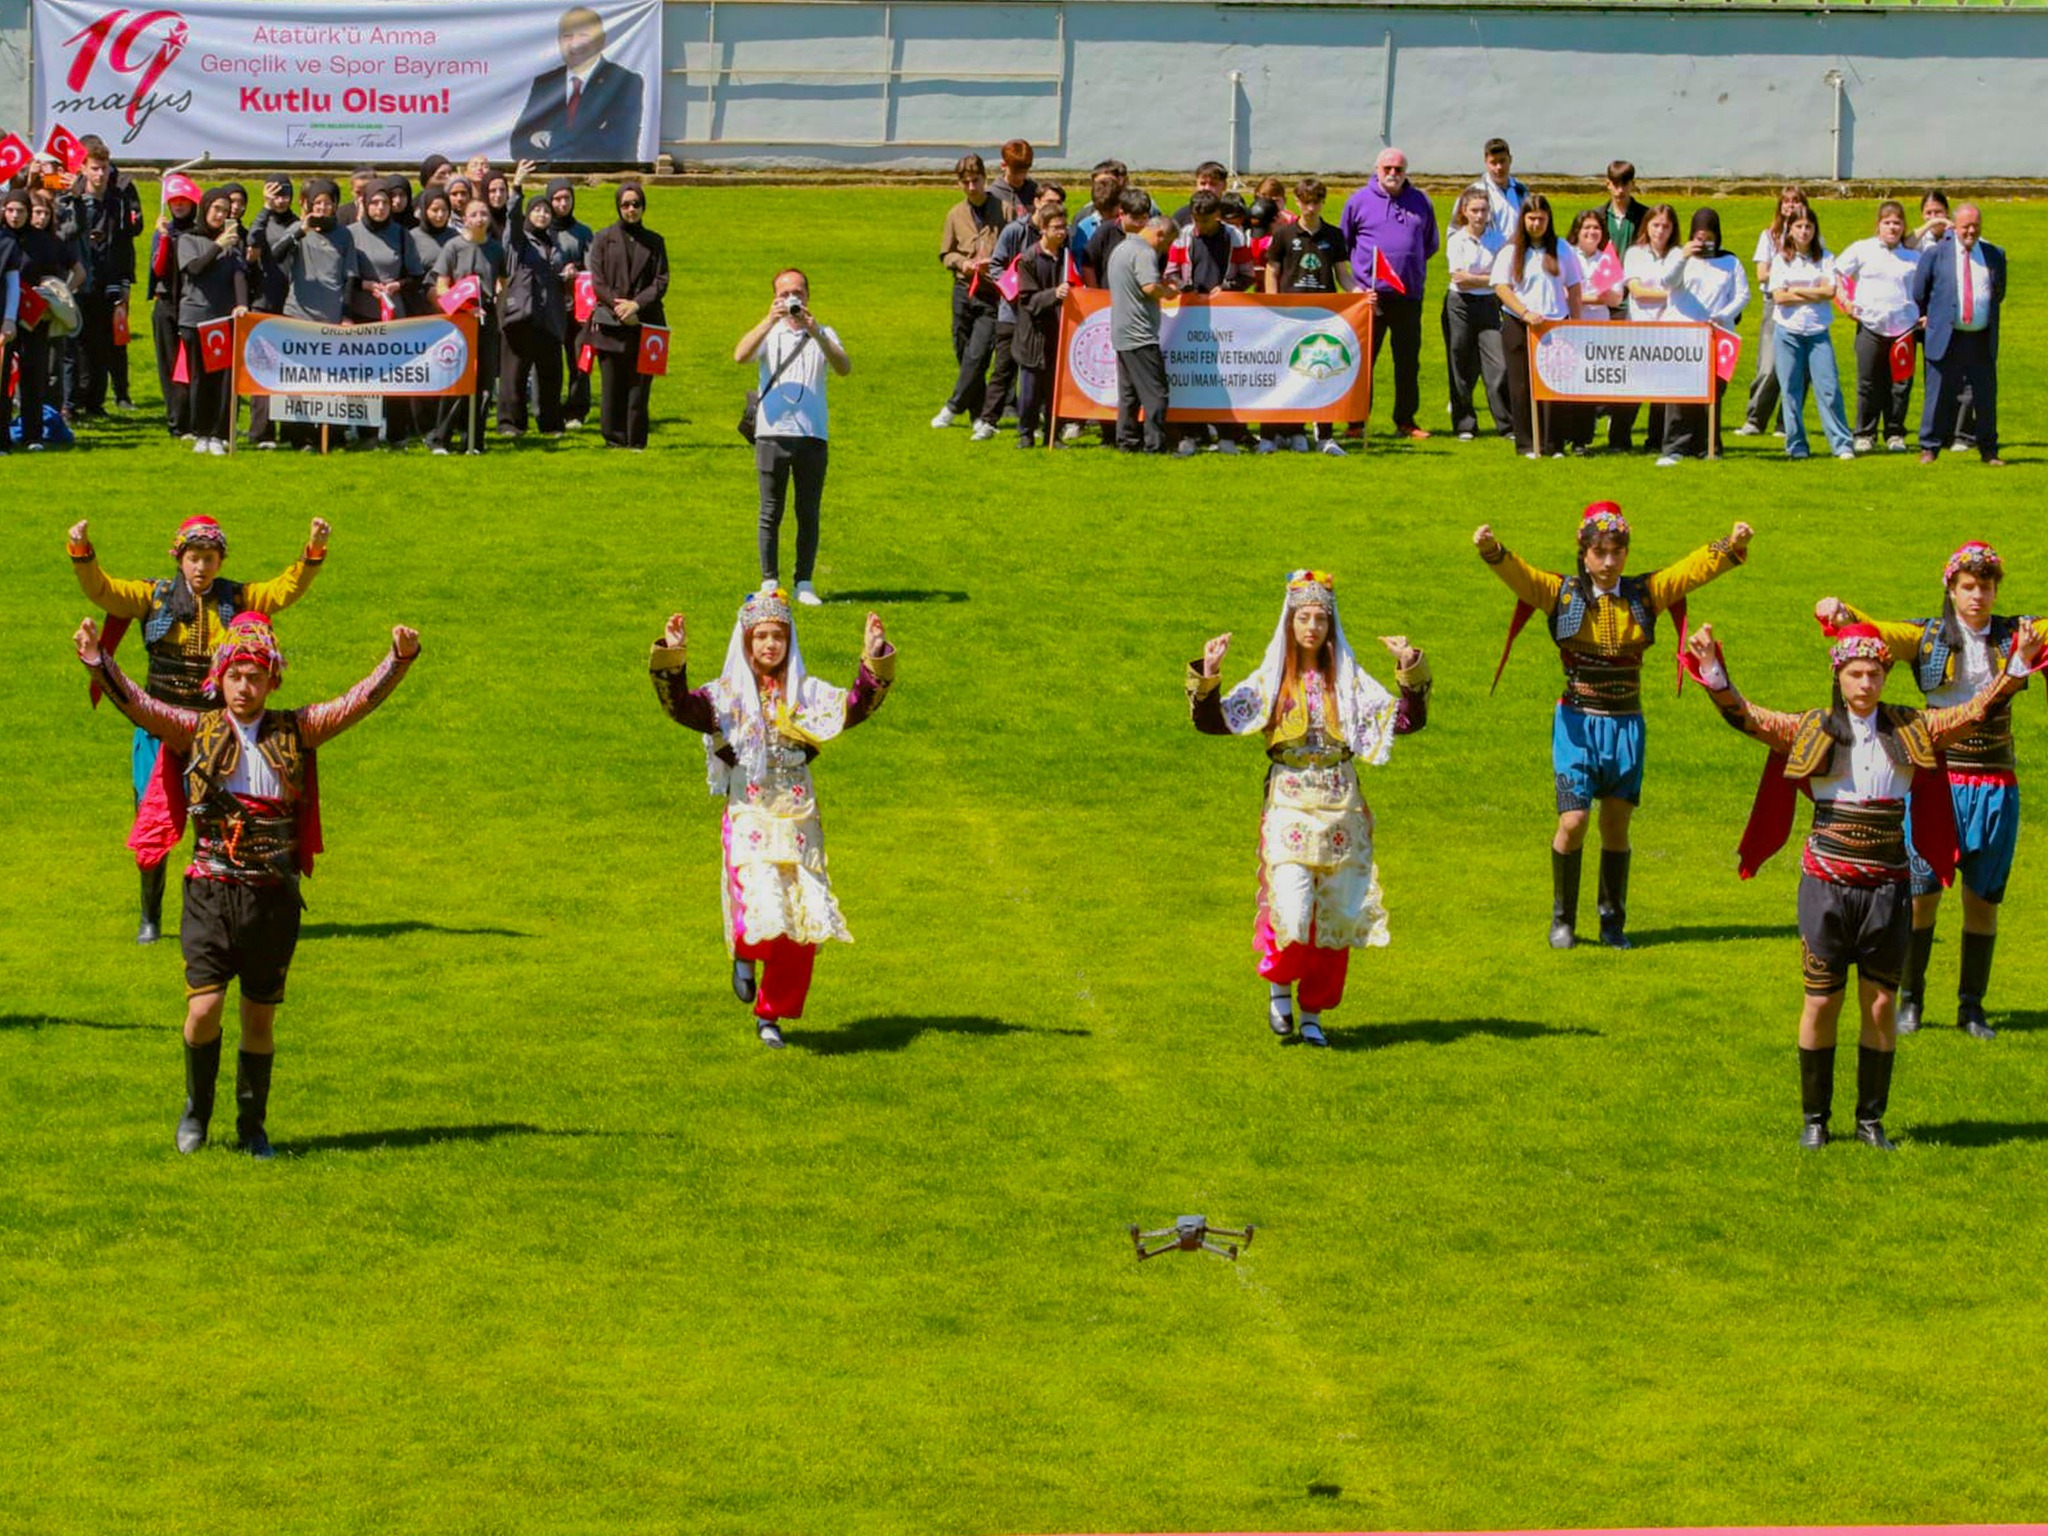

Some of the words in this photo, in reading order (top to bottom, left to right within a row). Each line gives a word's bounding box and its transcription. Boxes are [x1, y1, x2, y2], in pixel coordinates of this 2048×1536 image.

[253, 26, 361, 45] Atatürk'ü
[369, 27, 437, 46] Anma
[201, 54, 287, 77] Gençlik
[295, 59, 322, 73] ve
[330, 55, 385, 77] Spor
[394, 56, 488, 78] Bayramı
[239, 87, 331, 112] Kutlu
[343, 88, 449, 113] Olsun!
[282, 339, 332, 355] ÜNYE
[338, 341, 426, 356] ANADOLU
[1170, 347, 1199, 364] BAHRİ
[1200, 350, 1217, 364] FEN
[1219, 350, 1233, 364] VE
[1233, 348, 1281, 365] TEKNOLOJİ
[1585, 341, 1625, 361] ÜNYE
[1629, 345, 1703, 362] ANADOLU
[279, 363, 321, 383] İMAM
[327, 363, 374, 383] HATİP
[379, 362, 430, 384] LİSESİ
[1249, 370, 1276, 387] LİSESİ
[1585, 364, 1626, 384] LİSESİ
[285, 399, 323, 416] HATİP
